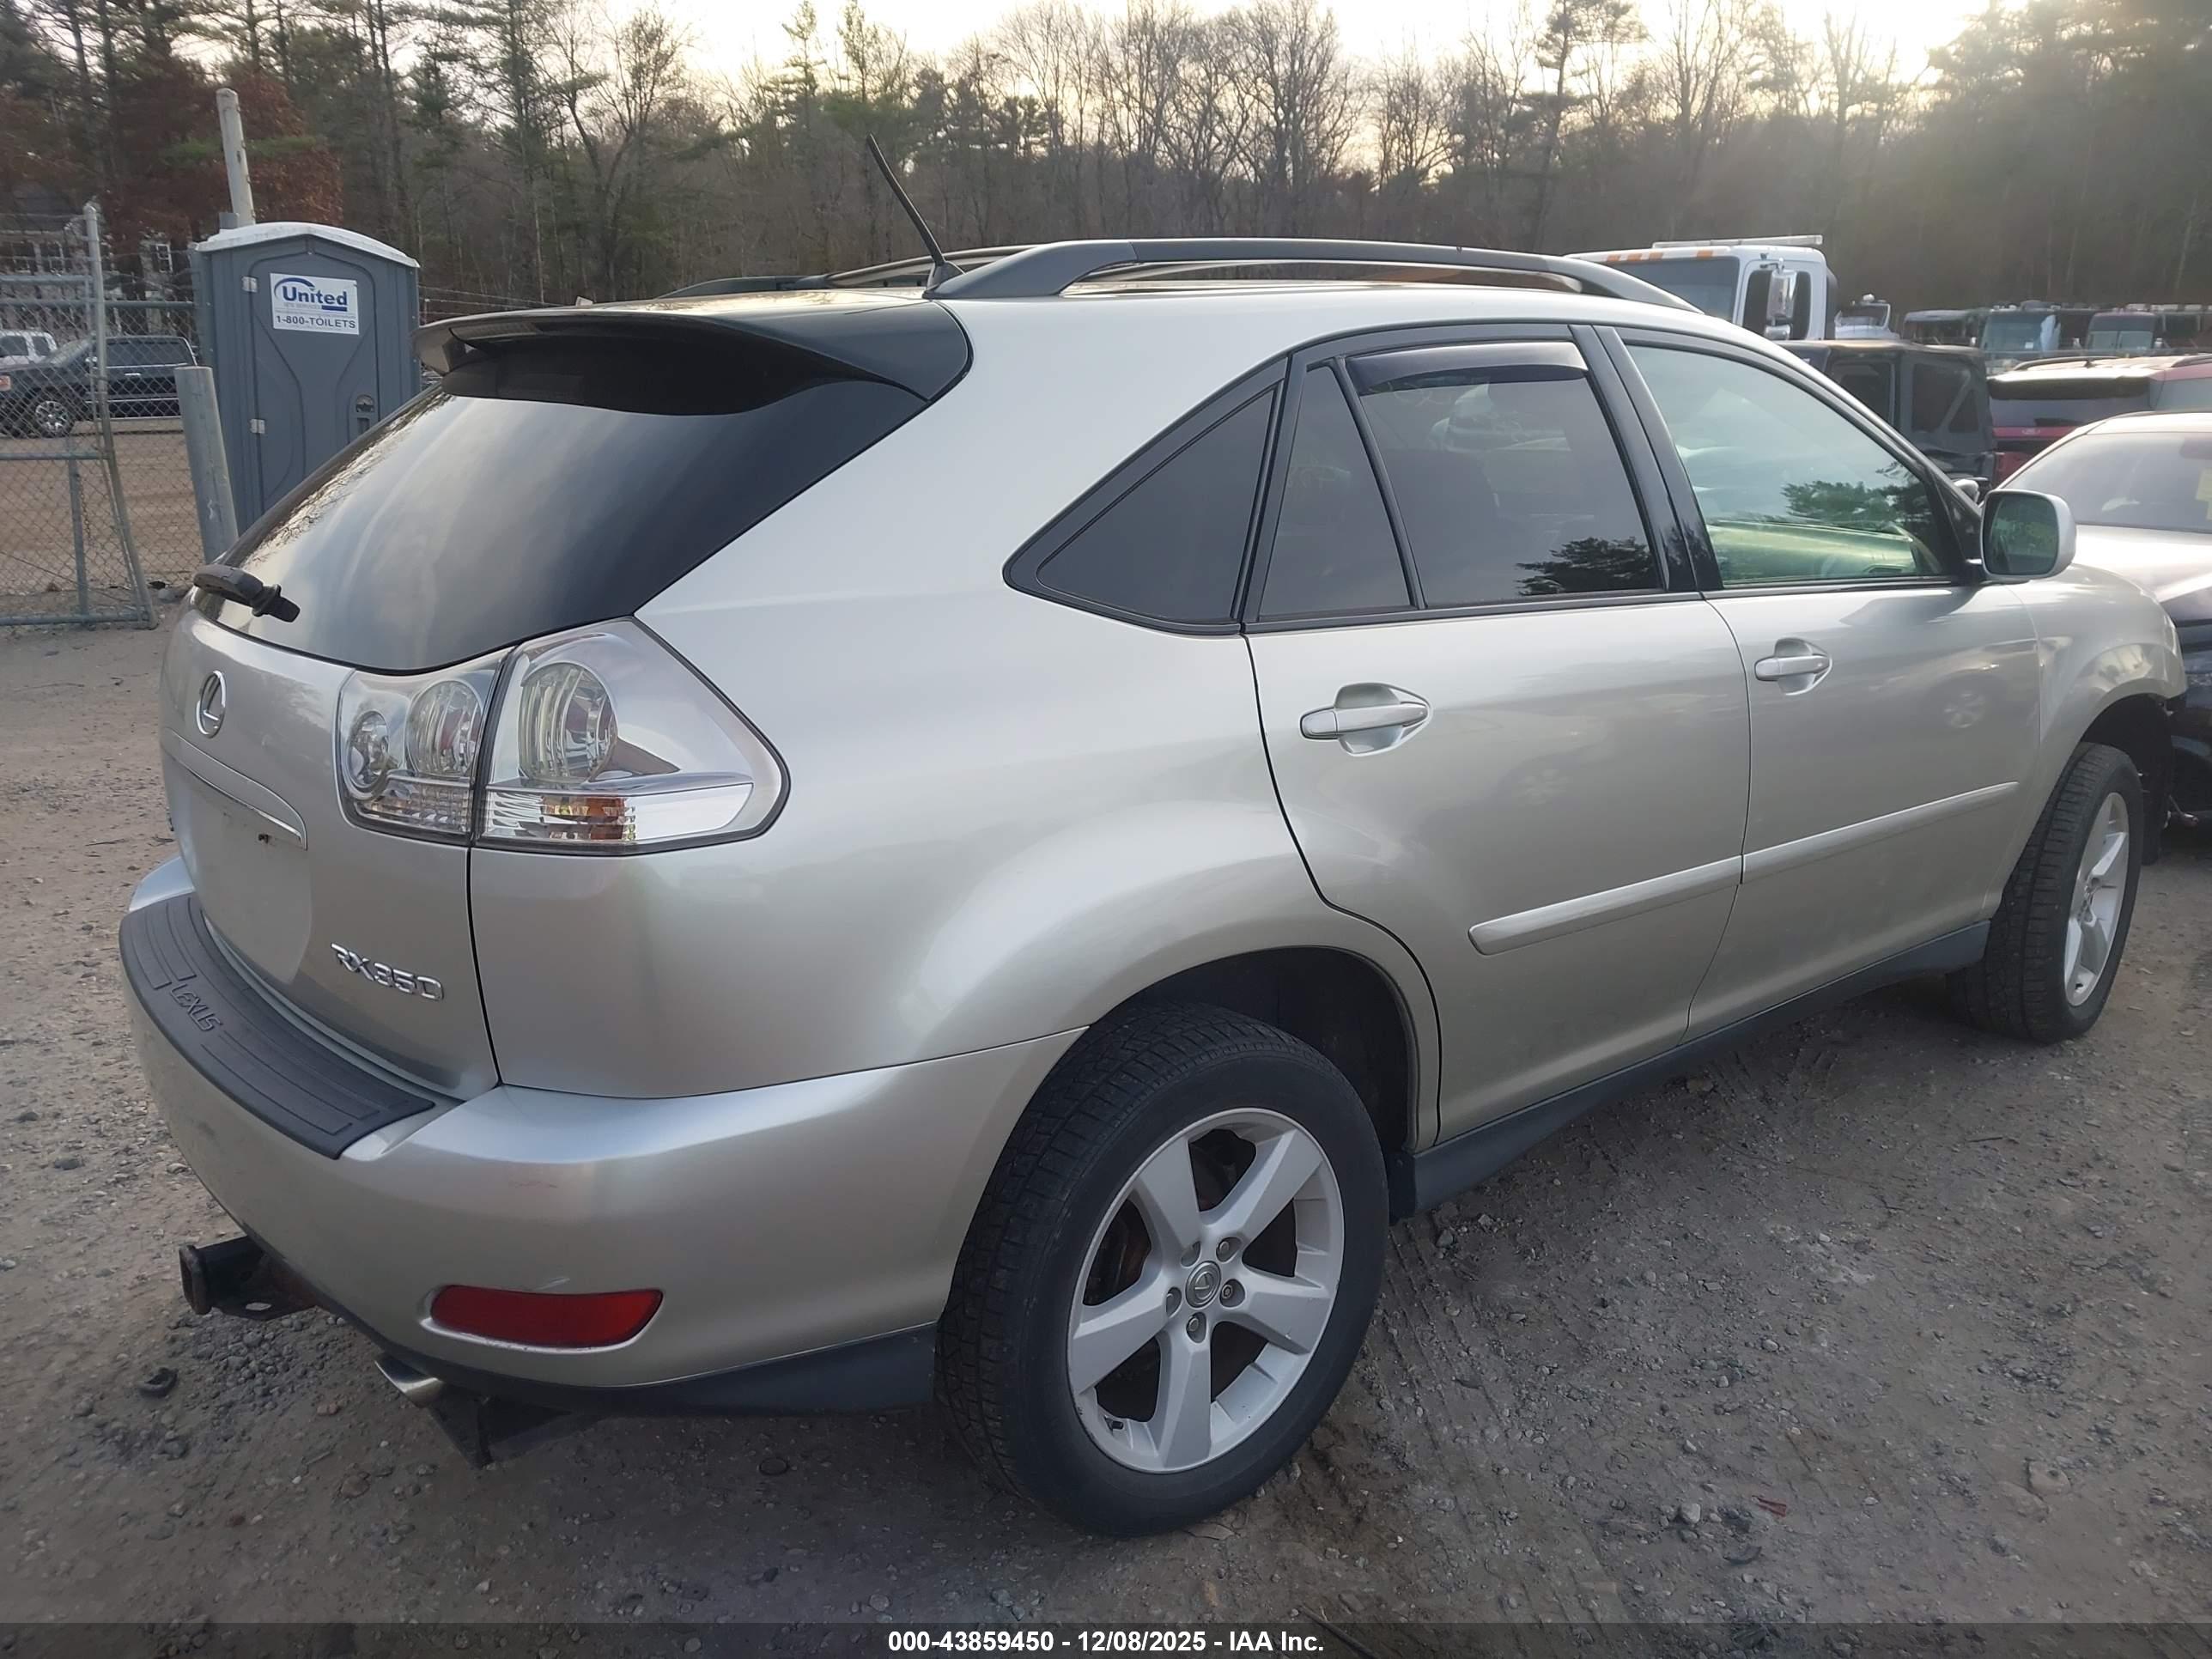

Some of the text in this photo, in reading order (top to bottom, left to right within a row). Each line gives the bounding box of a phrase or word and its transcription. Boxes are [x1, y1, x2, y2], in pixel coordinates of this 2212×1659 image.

[282, 285, 348, 306] United
[276, 315, 356, 329] 1-800-TOILETS
[170, 983, 223, 1031] LEXUS
